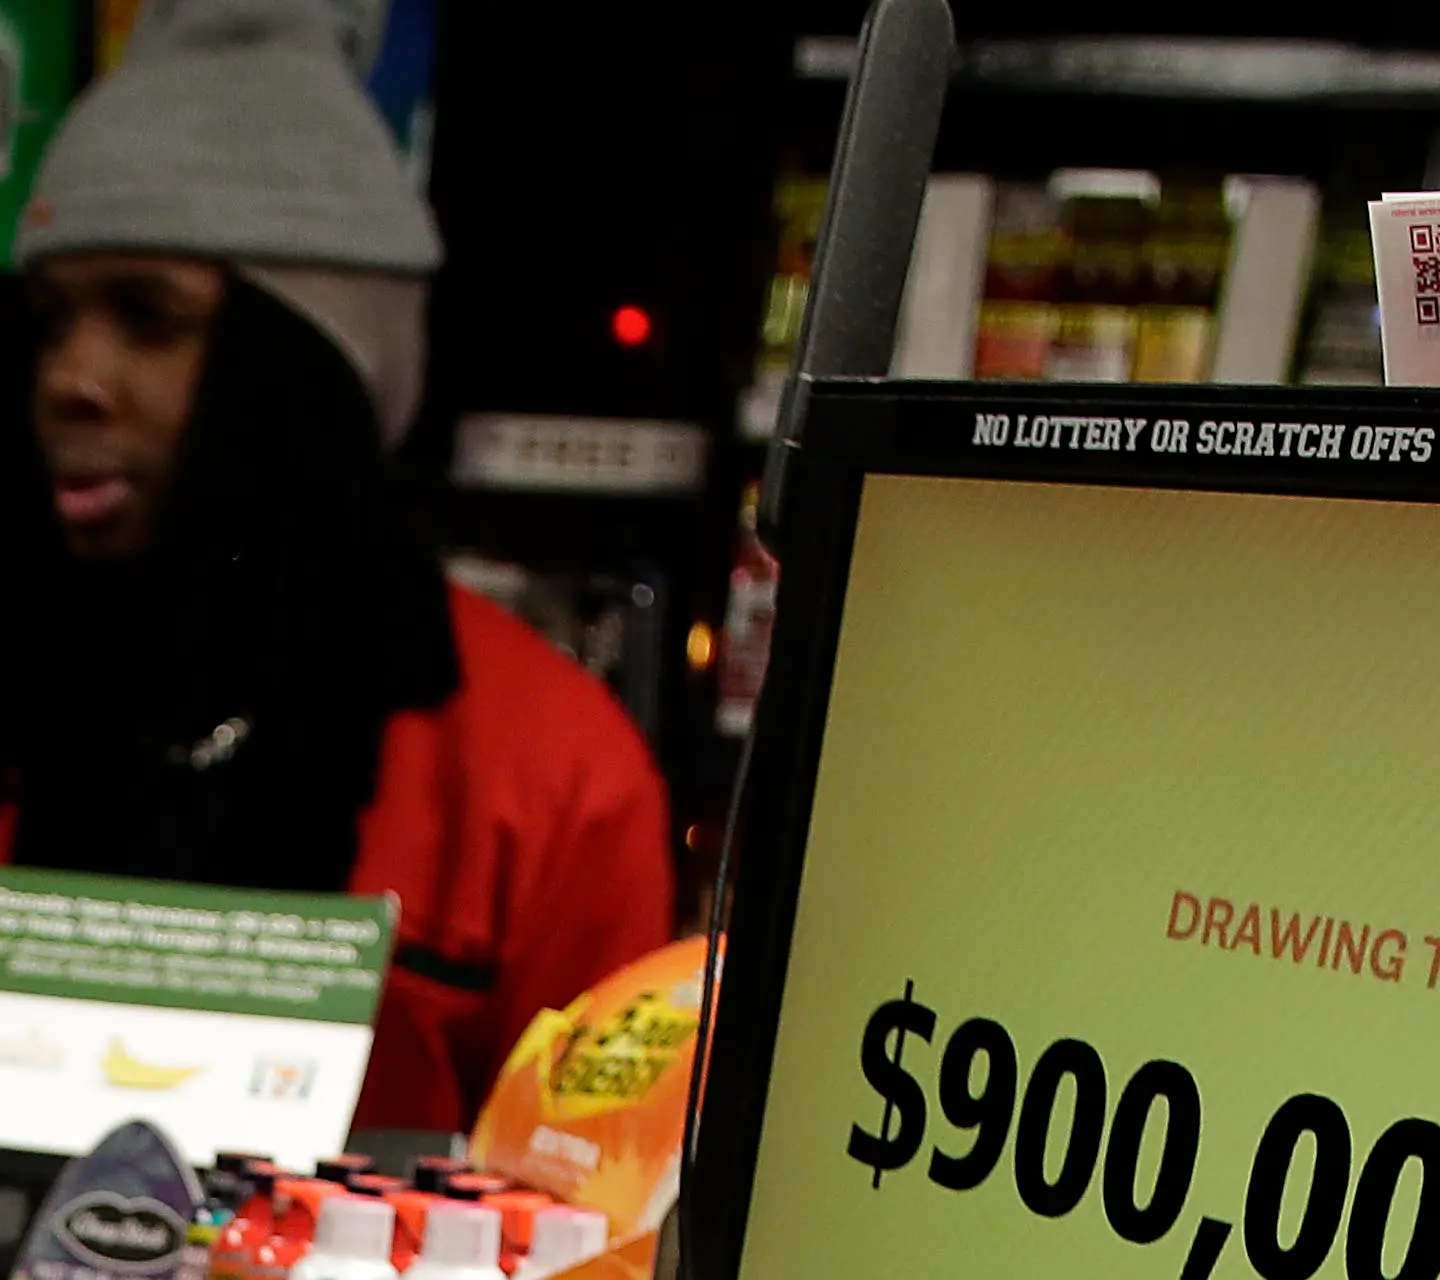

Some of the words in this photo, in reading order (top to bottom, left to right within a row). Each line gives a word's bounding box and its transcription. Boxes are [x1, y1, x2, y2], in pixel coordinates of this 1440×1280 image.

[973, 413, 1009, 447] NO
[1013, 415, 1142, 450] LOTTERY
[1151, 420, 1189, 454] OR
[1195, 421, 1345, 460] SCRATCH
[1351, 425, 1433, 464] OFFS
[1165, 890, 1407, 985] DRAWING
